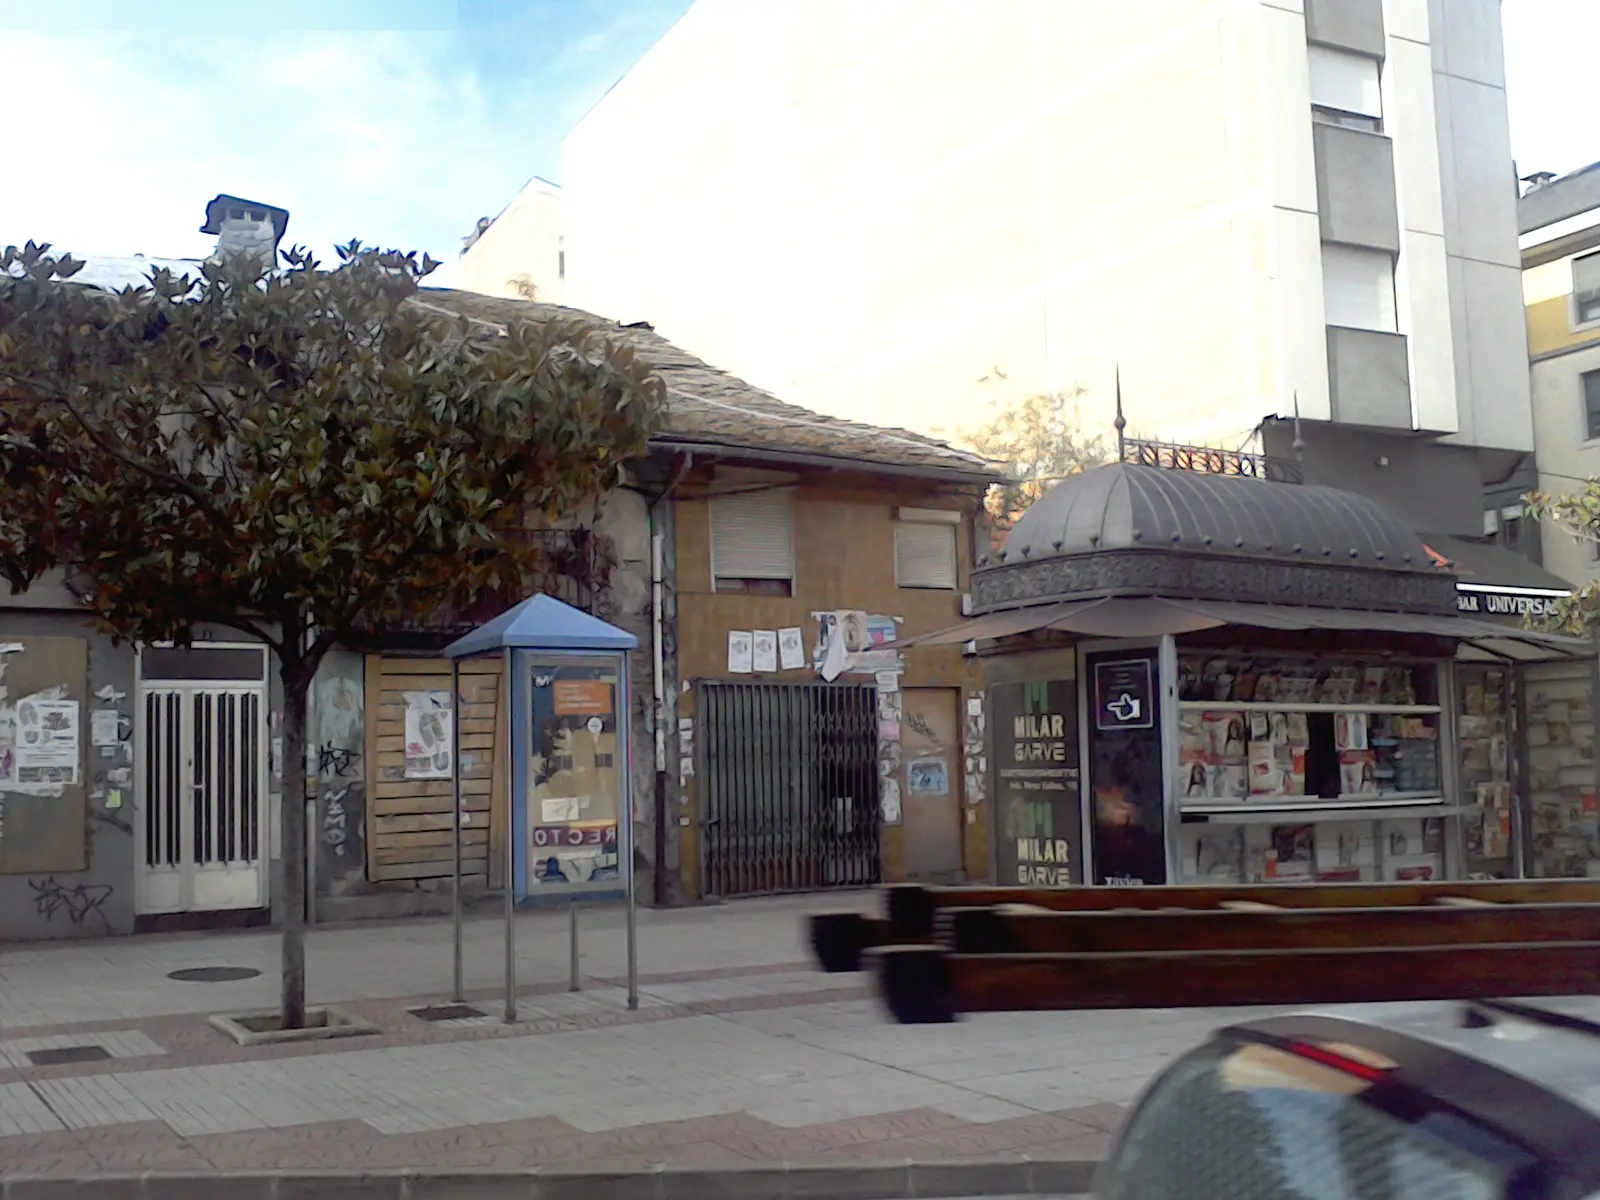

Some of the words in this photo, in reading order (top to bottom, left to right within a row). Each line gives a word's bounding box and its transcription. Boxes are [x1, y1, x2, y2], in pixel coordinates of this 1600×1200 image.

[1013, 714, 1064, 738] MILAR
[1014, 742, 1066, 762] GARVE
[1017, 838, 1069, 863] MILAR
[1017, 865, 1070, 886] GARVE
